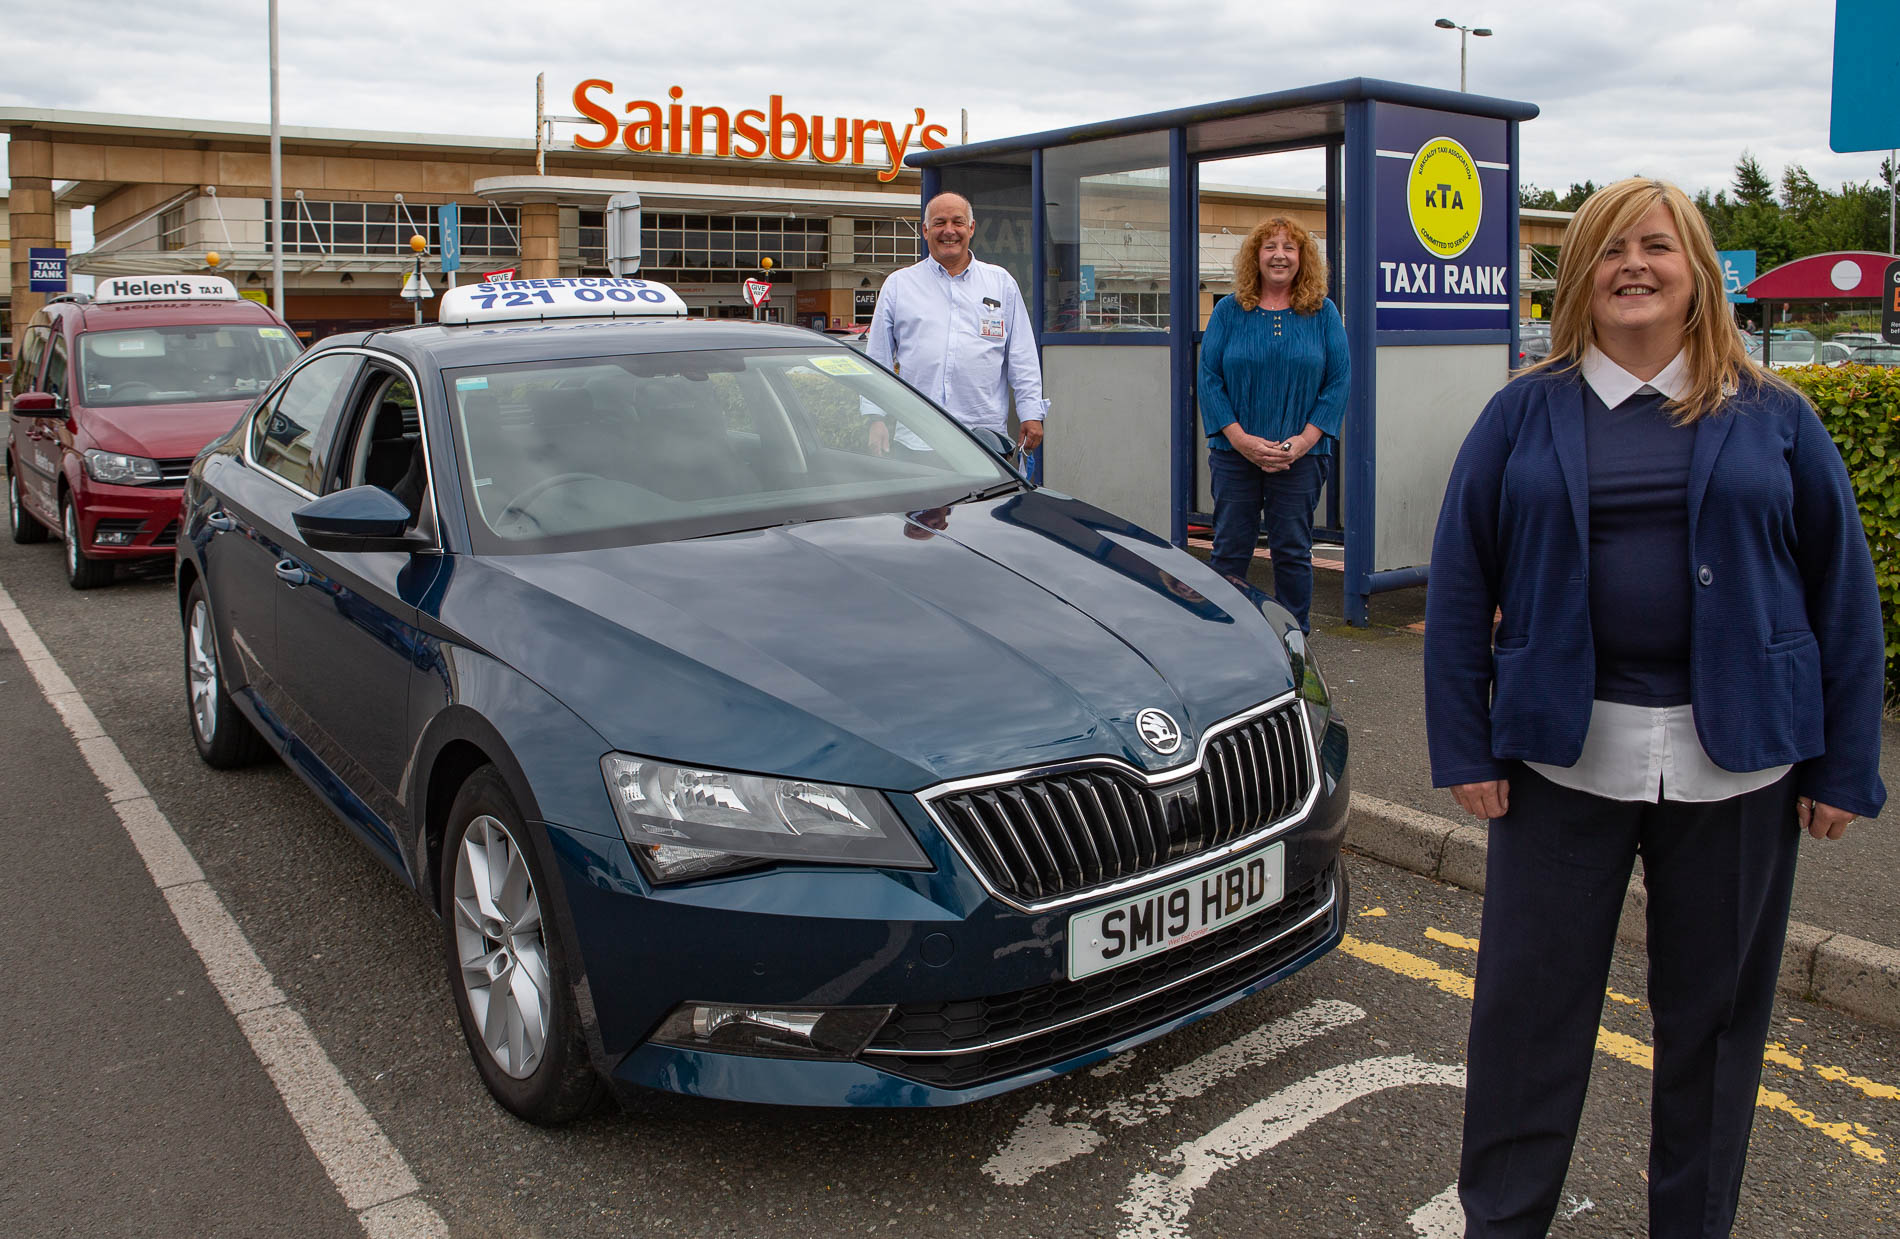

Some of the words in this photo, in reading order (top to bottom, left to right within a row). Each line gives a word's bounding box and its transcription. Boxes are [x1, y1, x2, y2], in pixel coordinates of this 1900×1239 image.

[572, 79, 948, 183] Sainsbury's
[1418, 148, 1437, 175] KIRKCALDY
[1448, 148, 1472, 180] ASSOCIATION
[1425, 184, 1464, 210] KTA
[1421, 228, 1447, 249] COMMITTED
[1454, 230, 1470, 247] SERVICE
[33, 270, 64, 278] RANK
[36, 262, 61, 270] TAXI
[477, 278, 649, 293] STREETCARS
[491, 273, 509, 282] GIVE
[1380, 262, 1436, 293] TAXI
[1444, 264, 1507, 295] RANK
[113, 280, 191, 296] Helen's
[199, 286, 223, 294] TAXI
[470, 290, 556, 309] 721
[574, 288, 666, 304] 000
[855, 293, 875, 303] CAFÉ
[1102, 295, 1119, 304] CAFÉ
[1101, 888, 1190, 959] SM19
[1201, 857, 1265, 926] HBD
[1167, 937, 1180, 946] West
[1181, 932, 1190, 941] End
[1190, 927, 1208, 937] Garage
